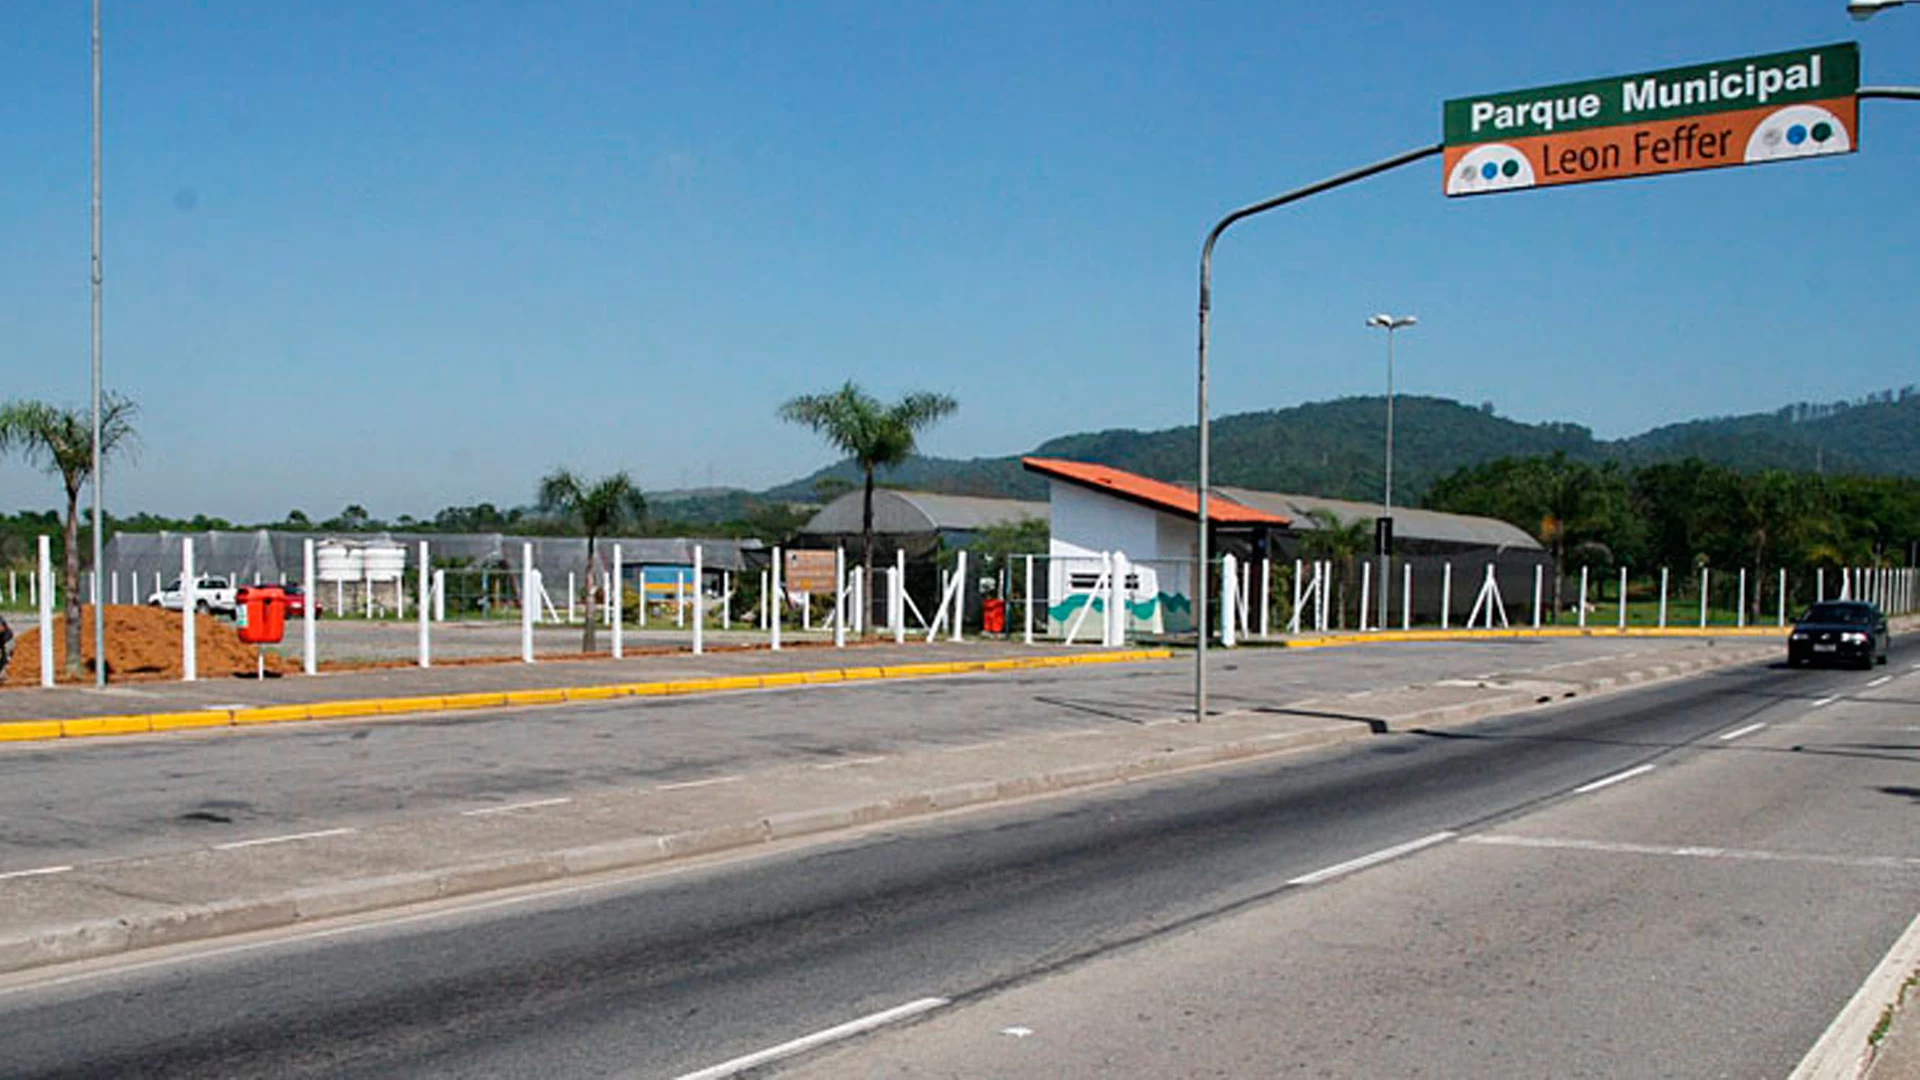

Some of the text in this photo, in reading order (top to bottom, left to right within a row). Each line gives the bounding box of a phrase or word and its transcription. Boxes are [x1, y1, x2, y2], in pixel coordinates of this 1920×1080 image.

[1471, 54, 1822, 132] Parque Municipal
[1543, 122, 1732, 176] Leon Feffer
